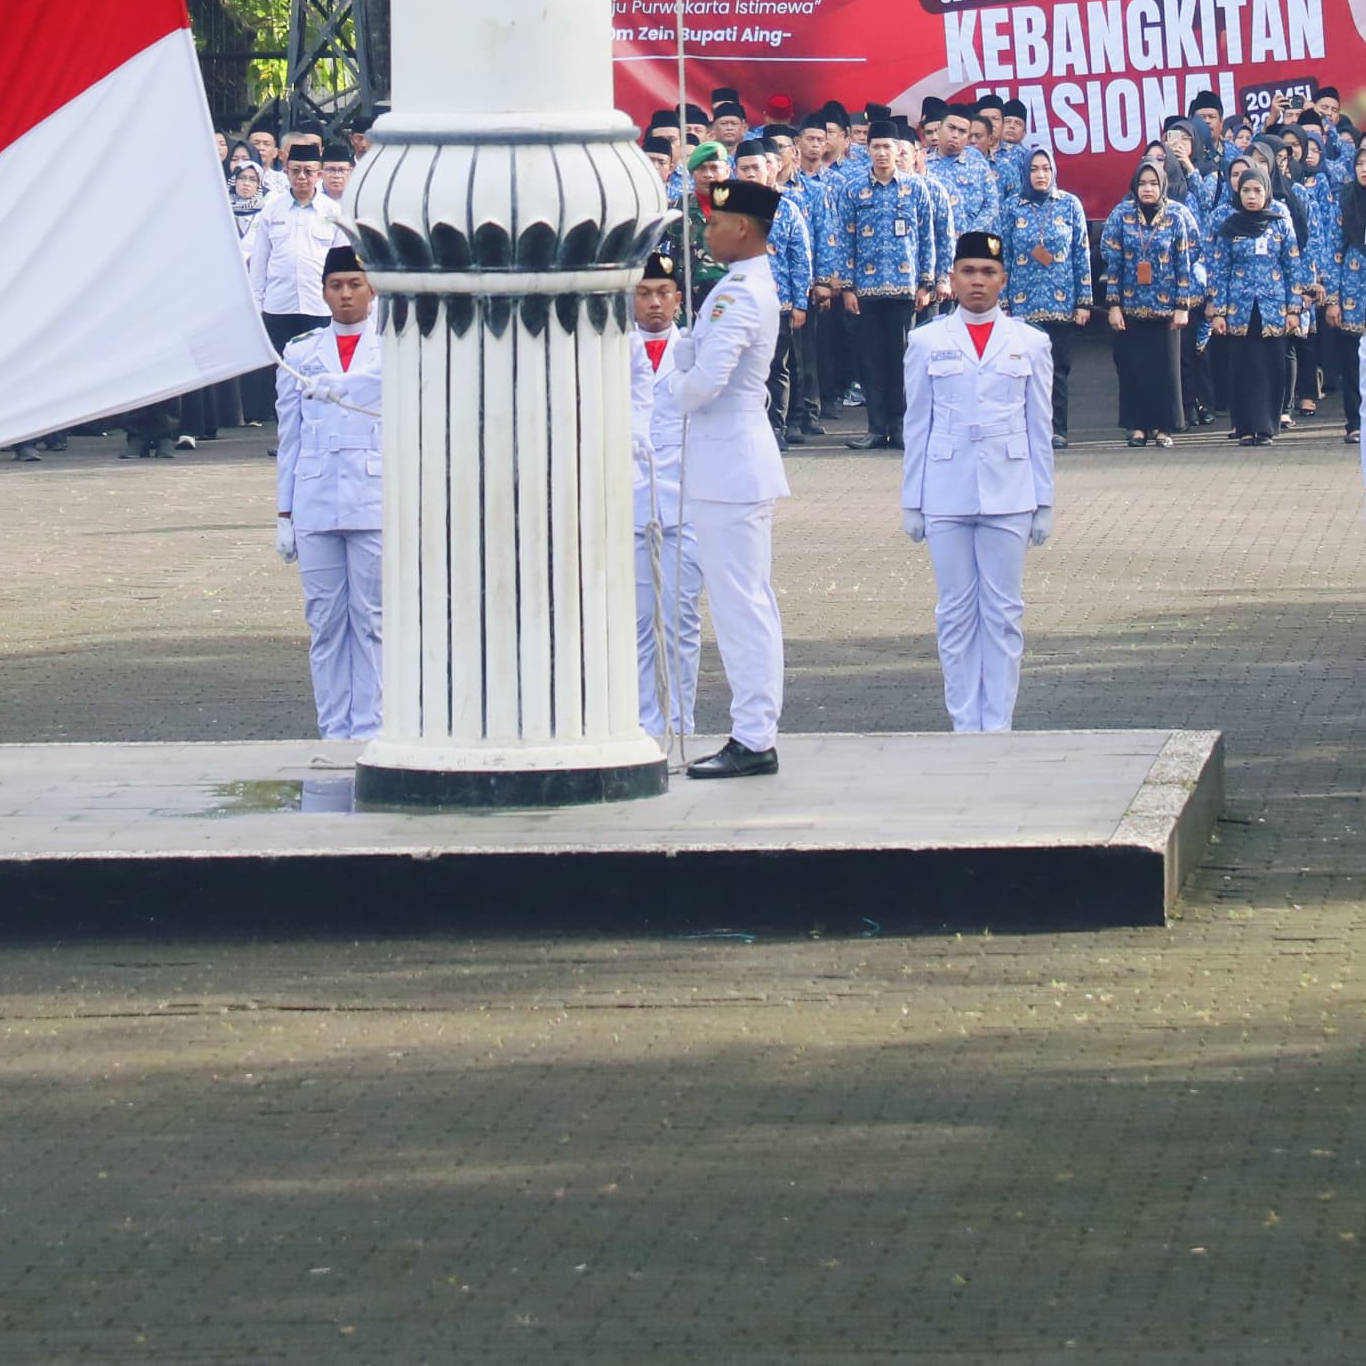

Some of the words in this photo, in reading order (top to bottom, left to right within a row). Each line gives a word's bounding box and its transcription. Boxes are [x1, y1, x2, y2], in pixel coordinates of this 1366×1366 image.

[638, 26, 674, 40] Zein
[682, 26, 737, 46] Bupati
[1246, 90, 1271, 111] 20
[975, 71, 1236, 155] ASION
